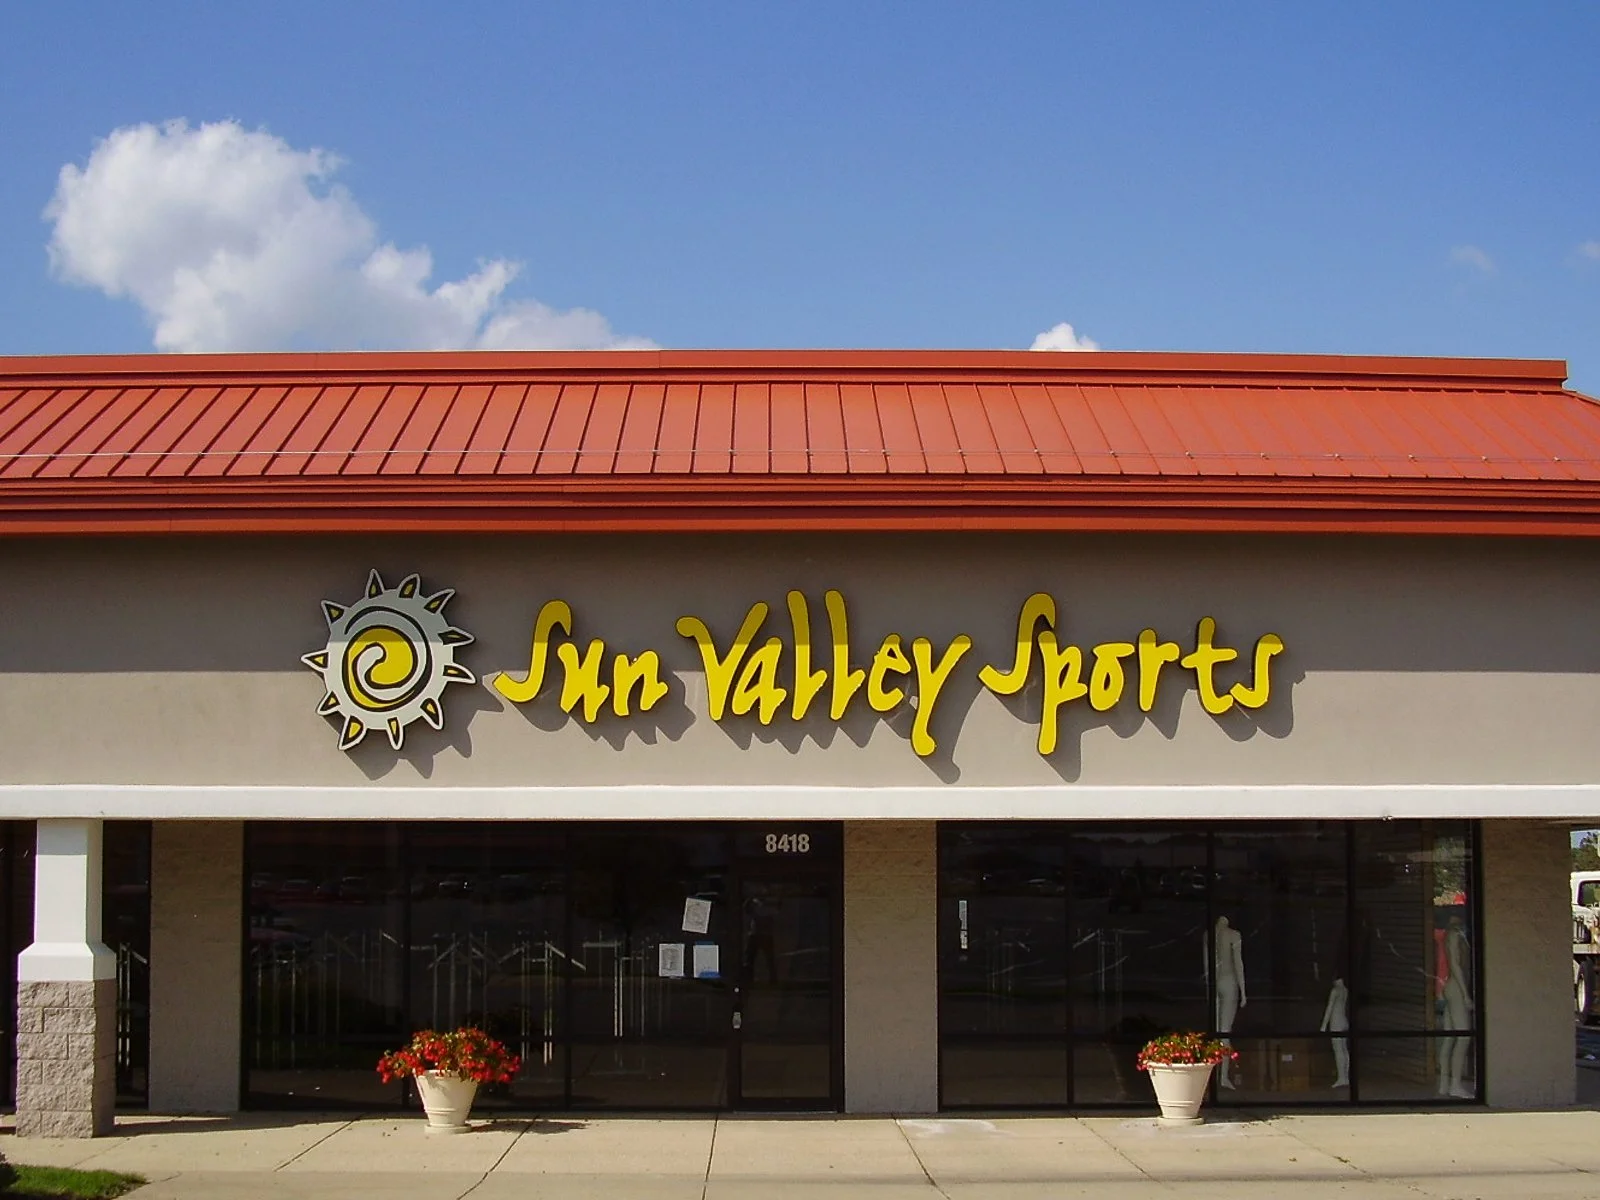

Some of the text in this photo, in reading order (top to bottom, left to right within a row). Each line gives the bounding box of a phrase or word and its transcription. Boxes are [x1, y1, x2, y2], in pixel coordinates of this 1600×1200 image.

[493, 590, 1284, 755] Sun Valley Sports
[765, 833, 810, 853] 8418
